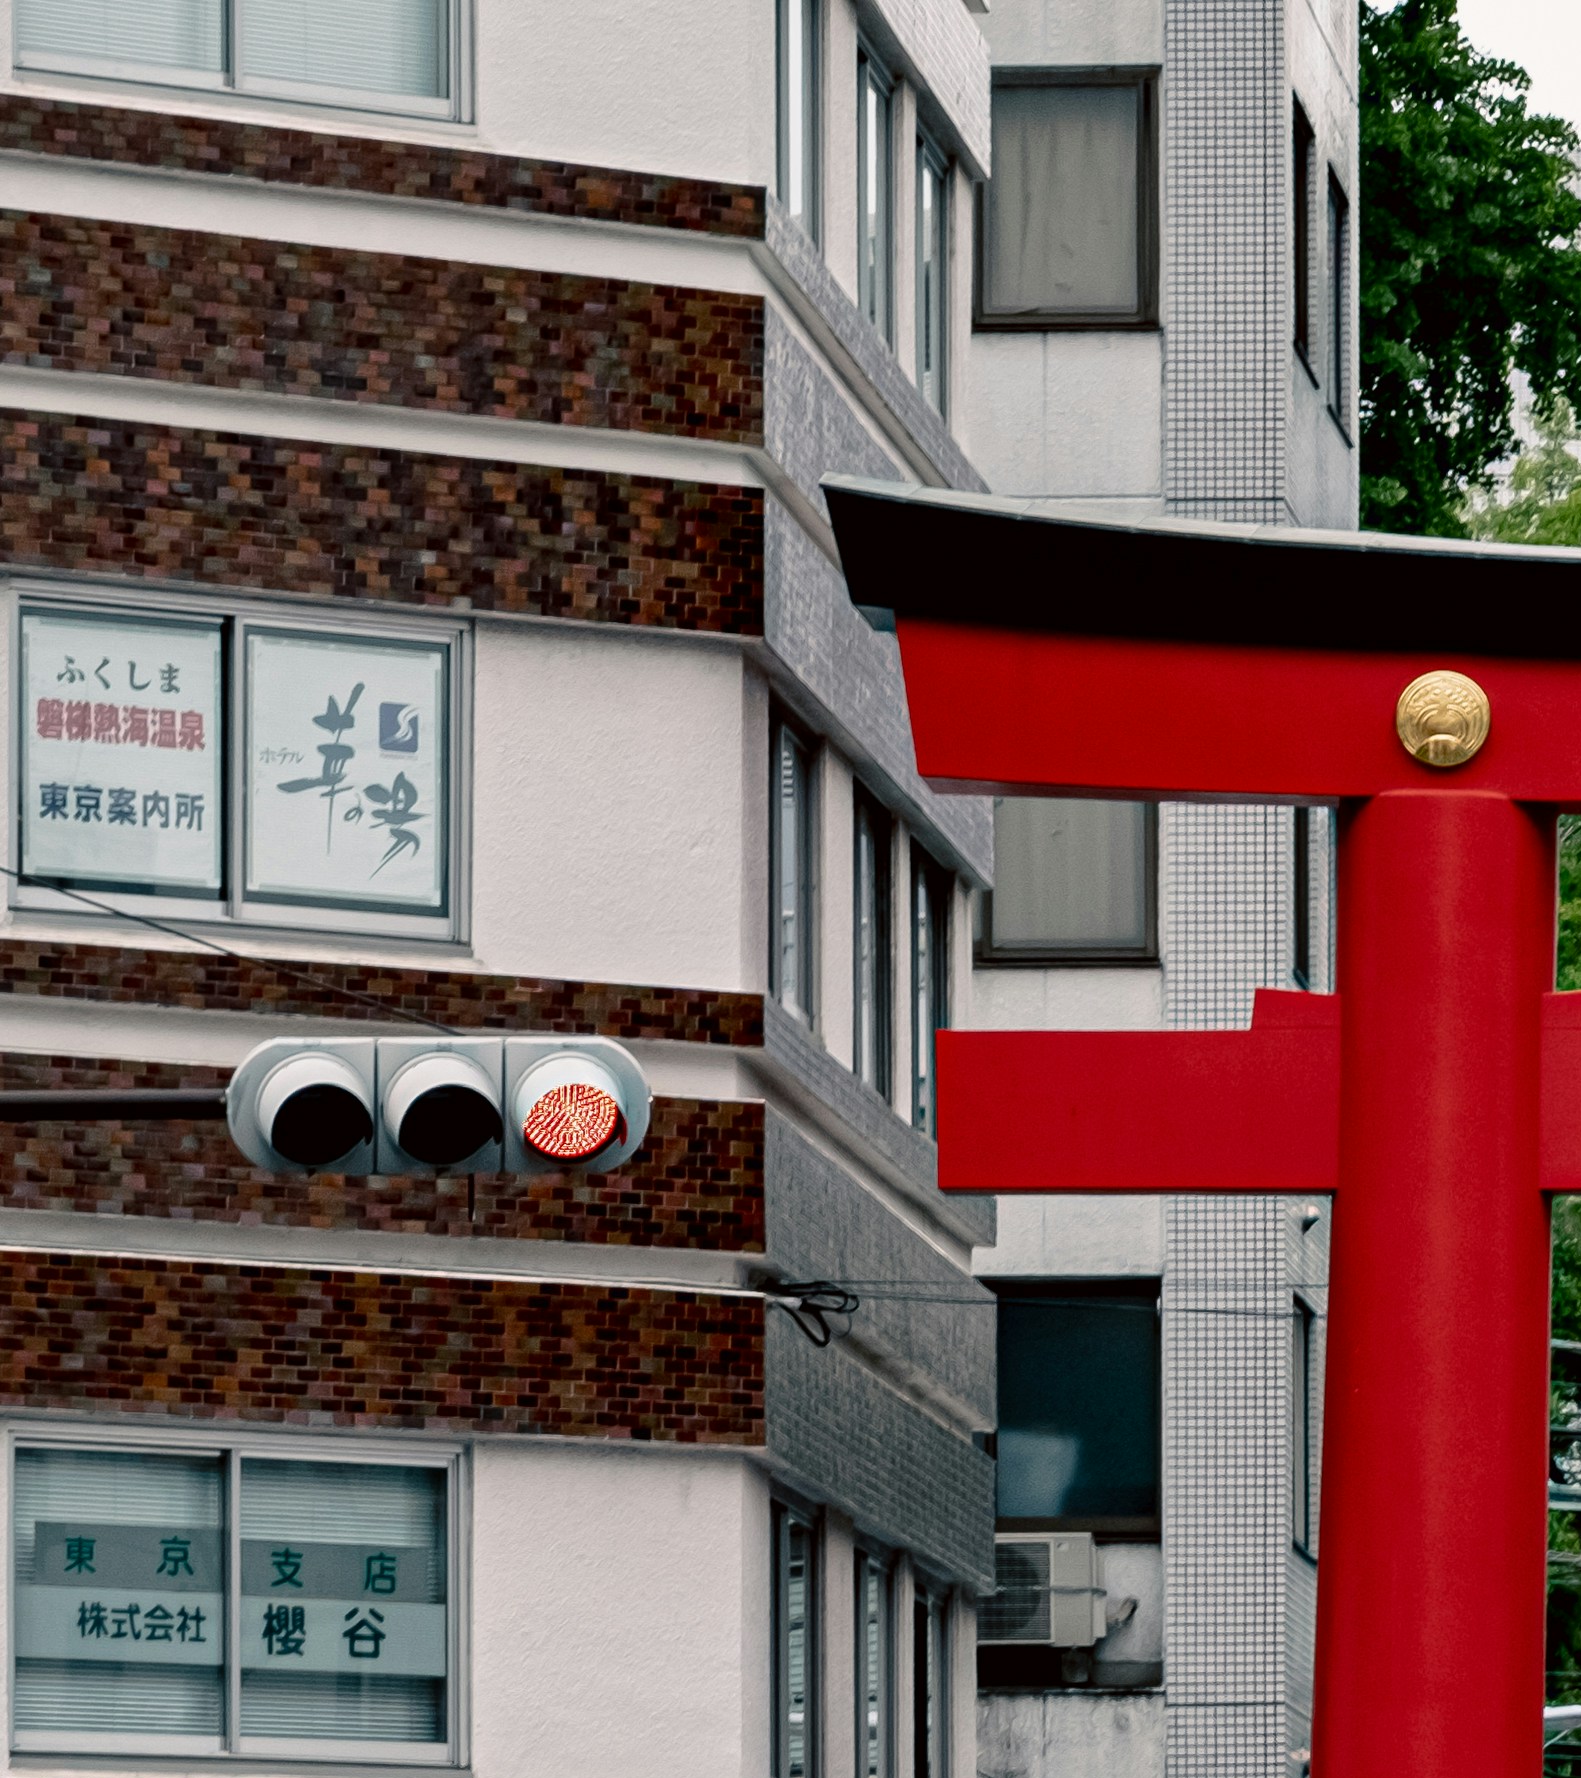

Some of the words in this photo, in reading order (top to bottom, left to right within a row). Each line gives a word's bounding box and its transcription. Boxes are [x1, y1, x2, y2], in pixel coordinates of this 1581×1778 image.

[56, 656, 181, 693] ふくしま
[37, 697, 205, 752] 磐梯熱海温泉
[259, 746, 304, 765] ホテル
[39, 781, 205, 832] 東京案内所
[77, 1600, 207, 1643] 株式会社
[262, 1603, 387, 1659] 櫻谷
